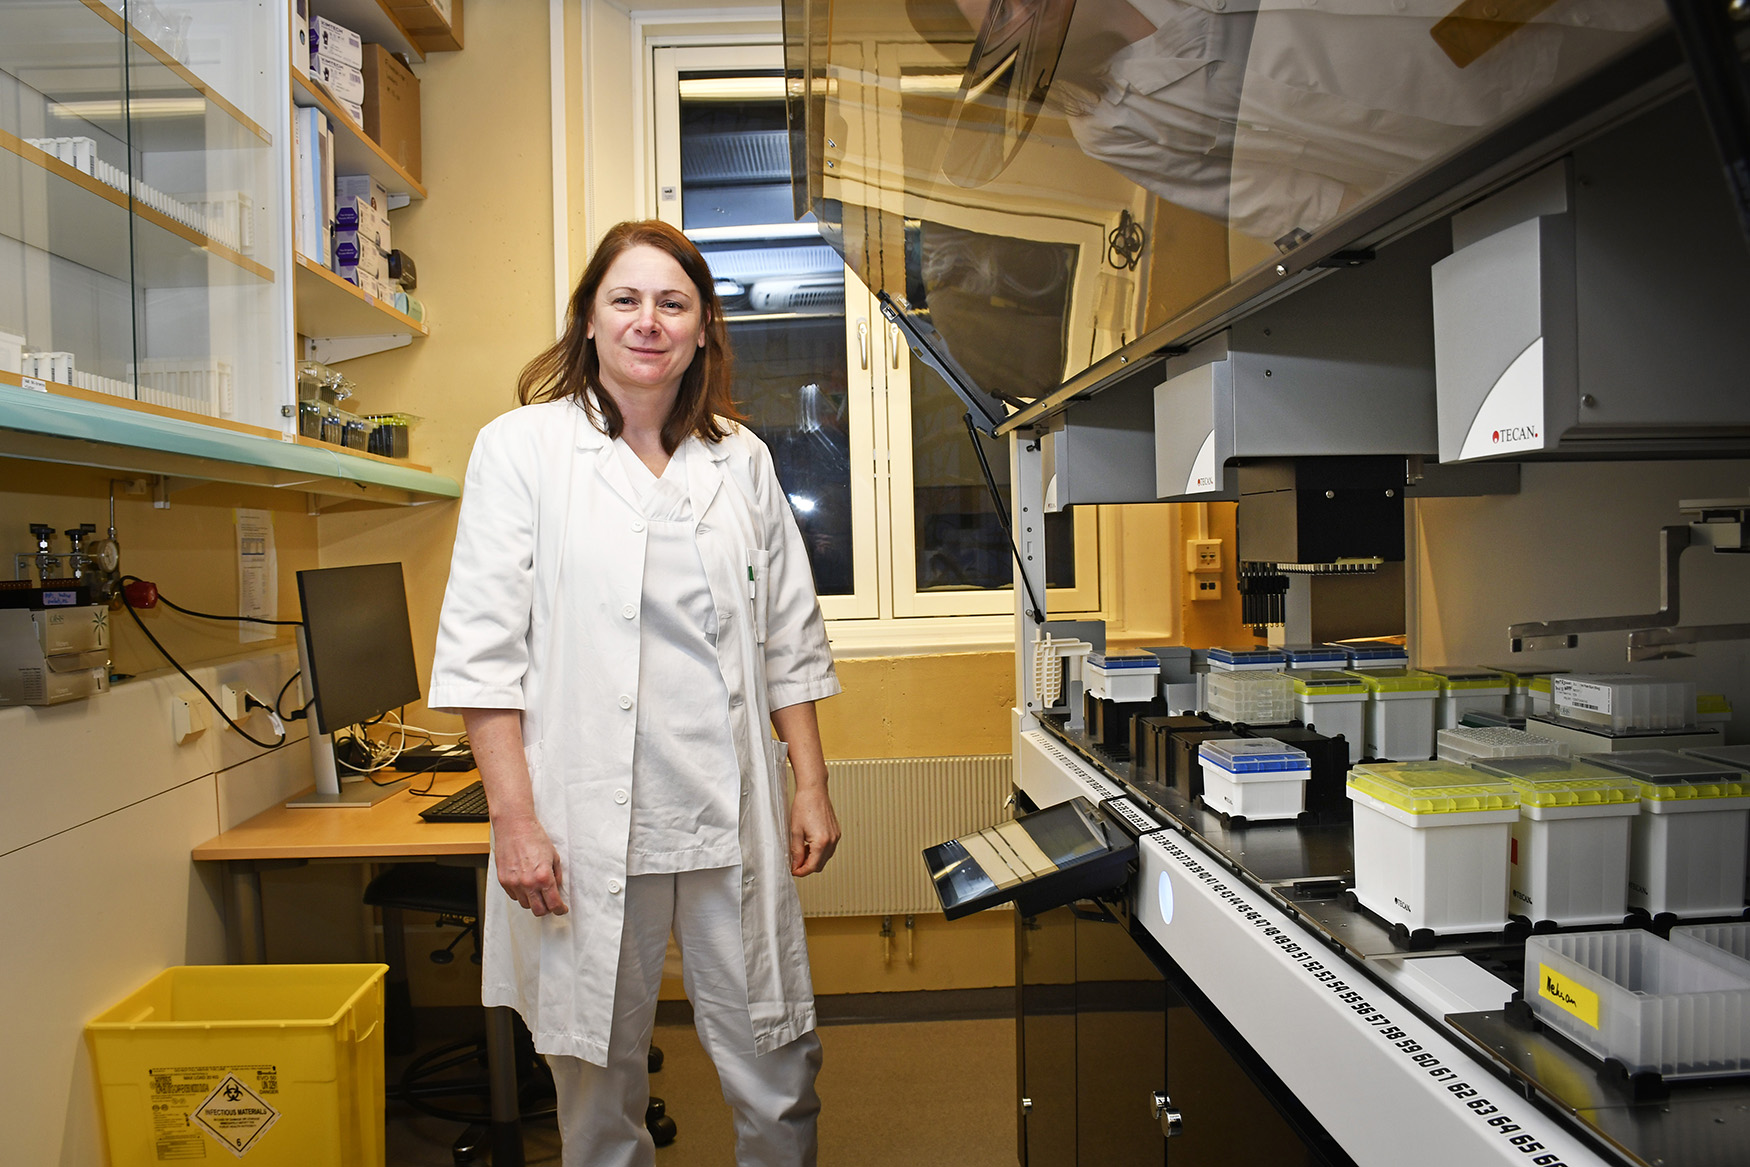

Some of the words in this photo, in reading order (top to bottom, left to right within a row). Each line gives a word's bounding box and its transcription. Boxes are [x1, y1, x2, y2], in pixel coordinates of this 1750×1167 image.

[1236, 904, 1252, 912] 45
[1245, 911, 1261, 920] 46
[1254, 919, 1271, 927] 47
[1263, 927, 1281, 936] 48
[1273, 935, 1291, 944] 49
[1281, 943, 1302, 953] 50
[1291, 952, 1312, 962] 51
[1302, 961, 1324, 972] 52
[1314, 971, 1336, 982] 53
[1326, 981, 1350, 992] 54
[1339, 991, 1364, 1004] 55
[1351, 1002, 1376, 1015] 56
[1365, 1014, 1391, 1026] 57
[1380, 1026, 1406, 1040] 58
[1395, 1039, 1423, 1054] 59
[1411, 1053, 1440, 1068] 60
[1429, 1067, 1458, 1082] 61
[1447, 1082, 1478, 1099] 62
[1466, 1099, 1498, 1116] 63
[1487, 1116, 1522, 1134] 64
[237, 1138, 242, 1147] 6
[1509, 1134, 1545, 1153] 65
